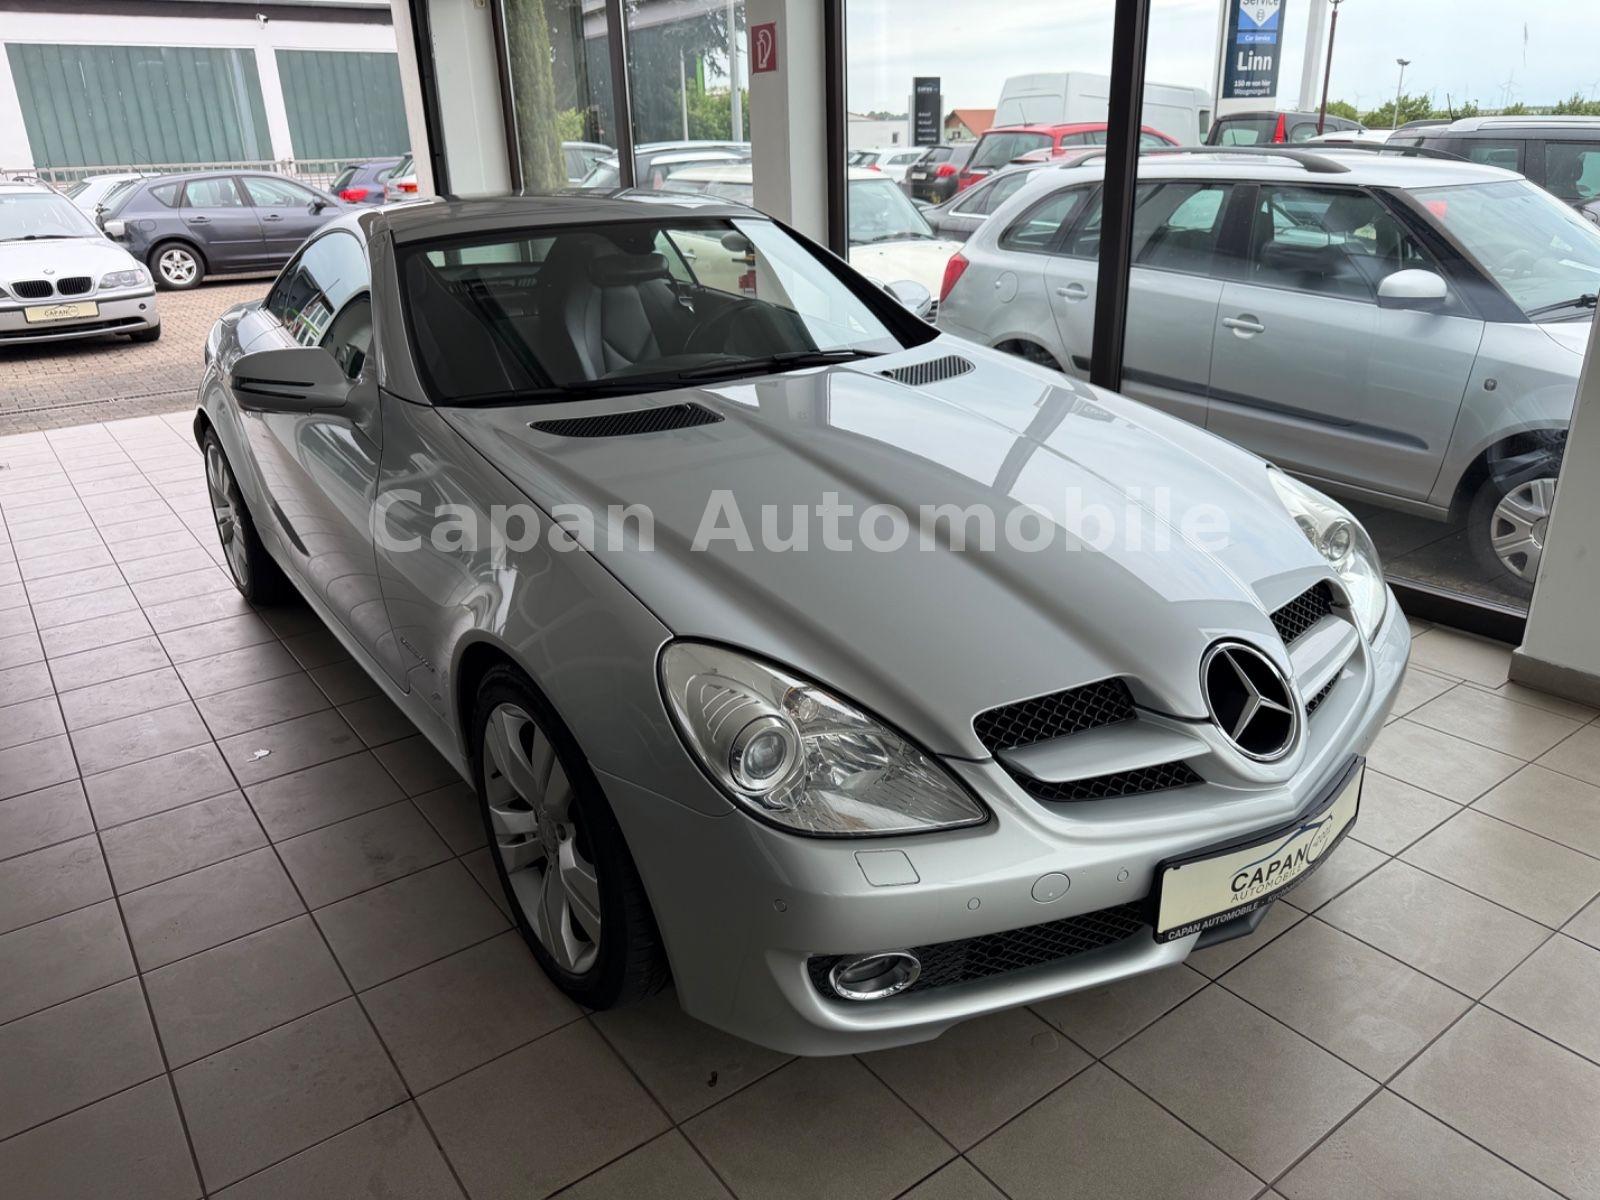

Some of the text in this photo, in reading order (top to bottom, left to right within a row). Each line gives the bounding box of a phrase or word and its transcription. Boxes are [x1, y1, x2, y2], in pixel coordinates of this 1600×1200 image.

[1237, 50, 1272, 71] Linn
[1231, 844, 1308, 893] CAPAN
[1168, 921, 1202, 941] CAPAN
[1201, 901, 1259, 930] AUTOMOBILE
